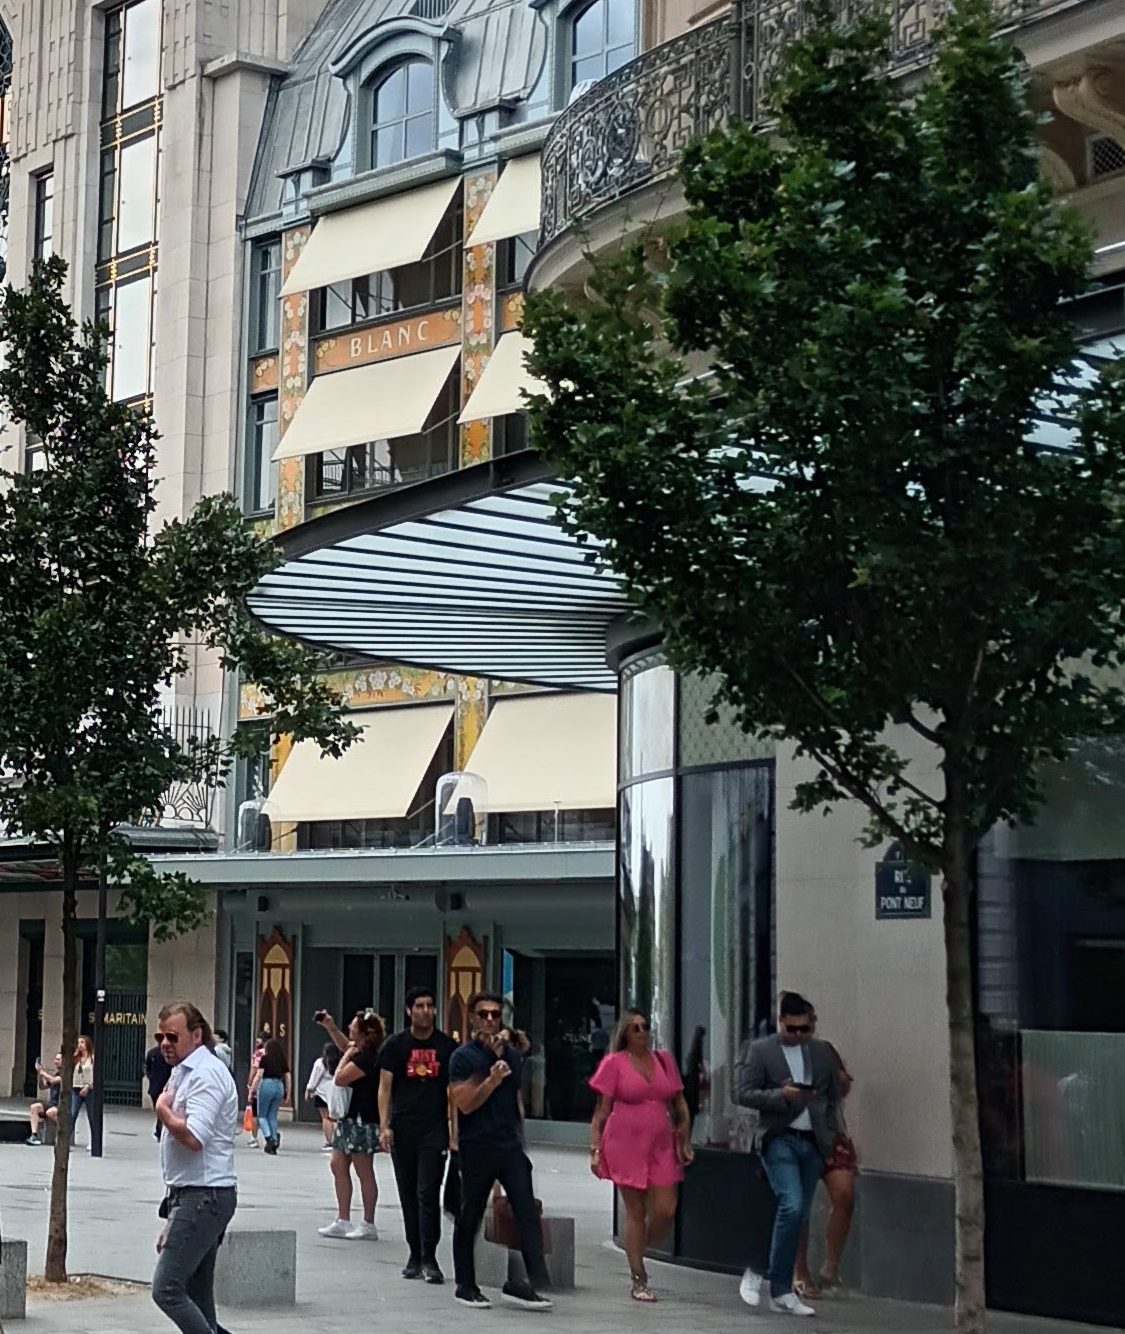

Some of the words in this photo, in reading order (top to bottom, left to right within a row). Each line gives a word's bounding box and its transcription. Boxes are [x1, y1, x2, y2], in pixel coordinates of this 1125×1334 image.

[351, 320, 429, 357] BLANC
[880, 896, 902, 910] PONT
[904, 896, 925, 910] NEUF
[88, 1012, 147, 1025] SMARITAIN
